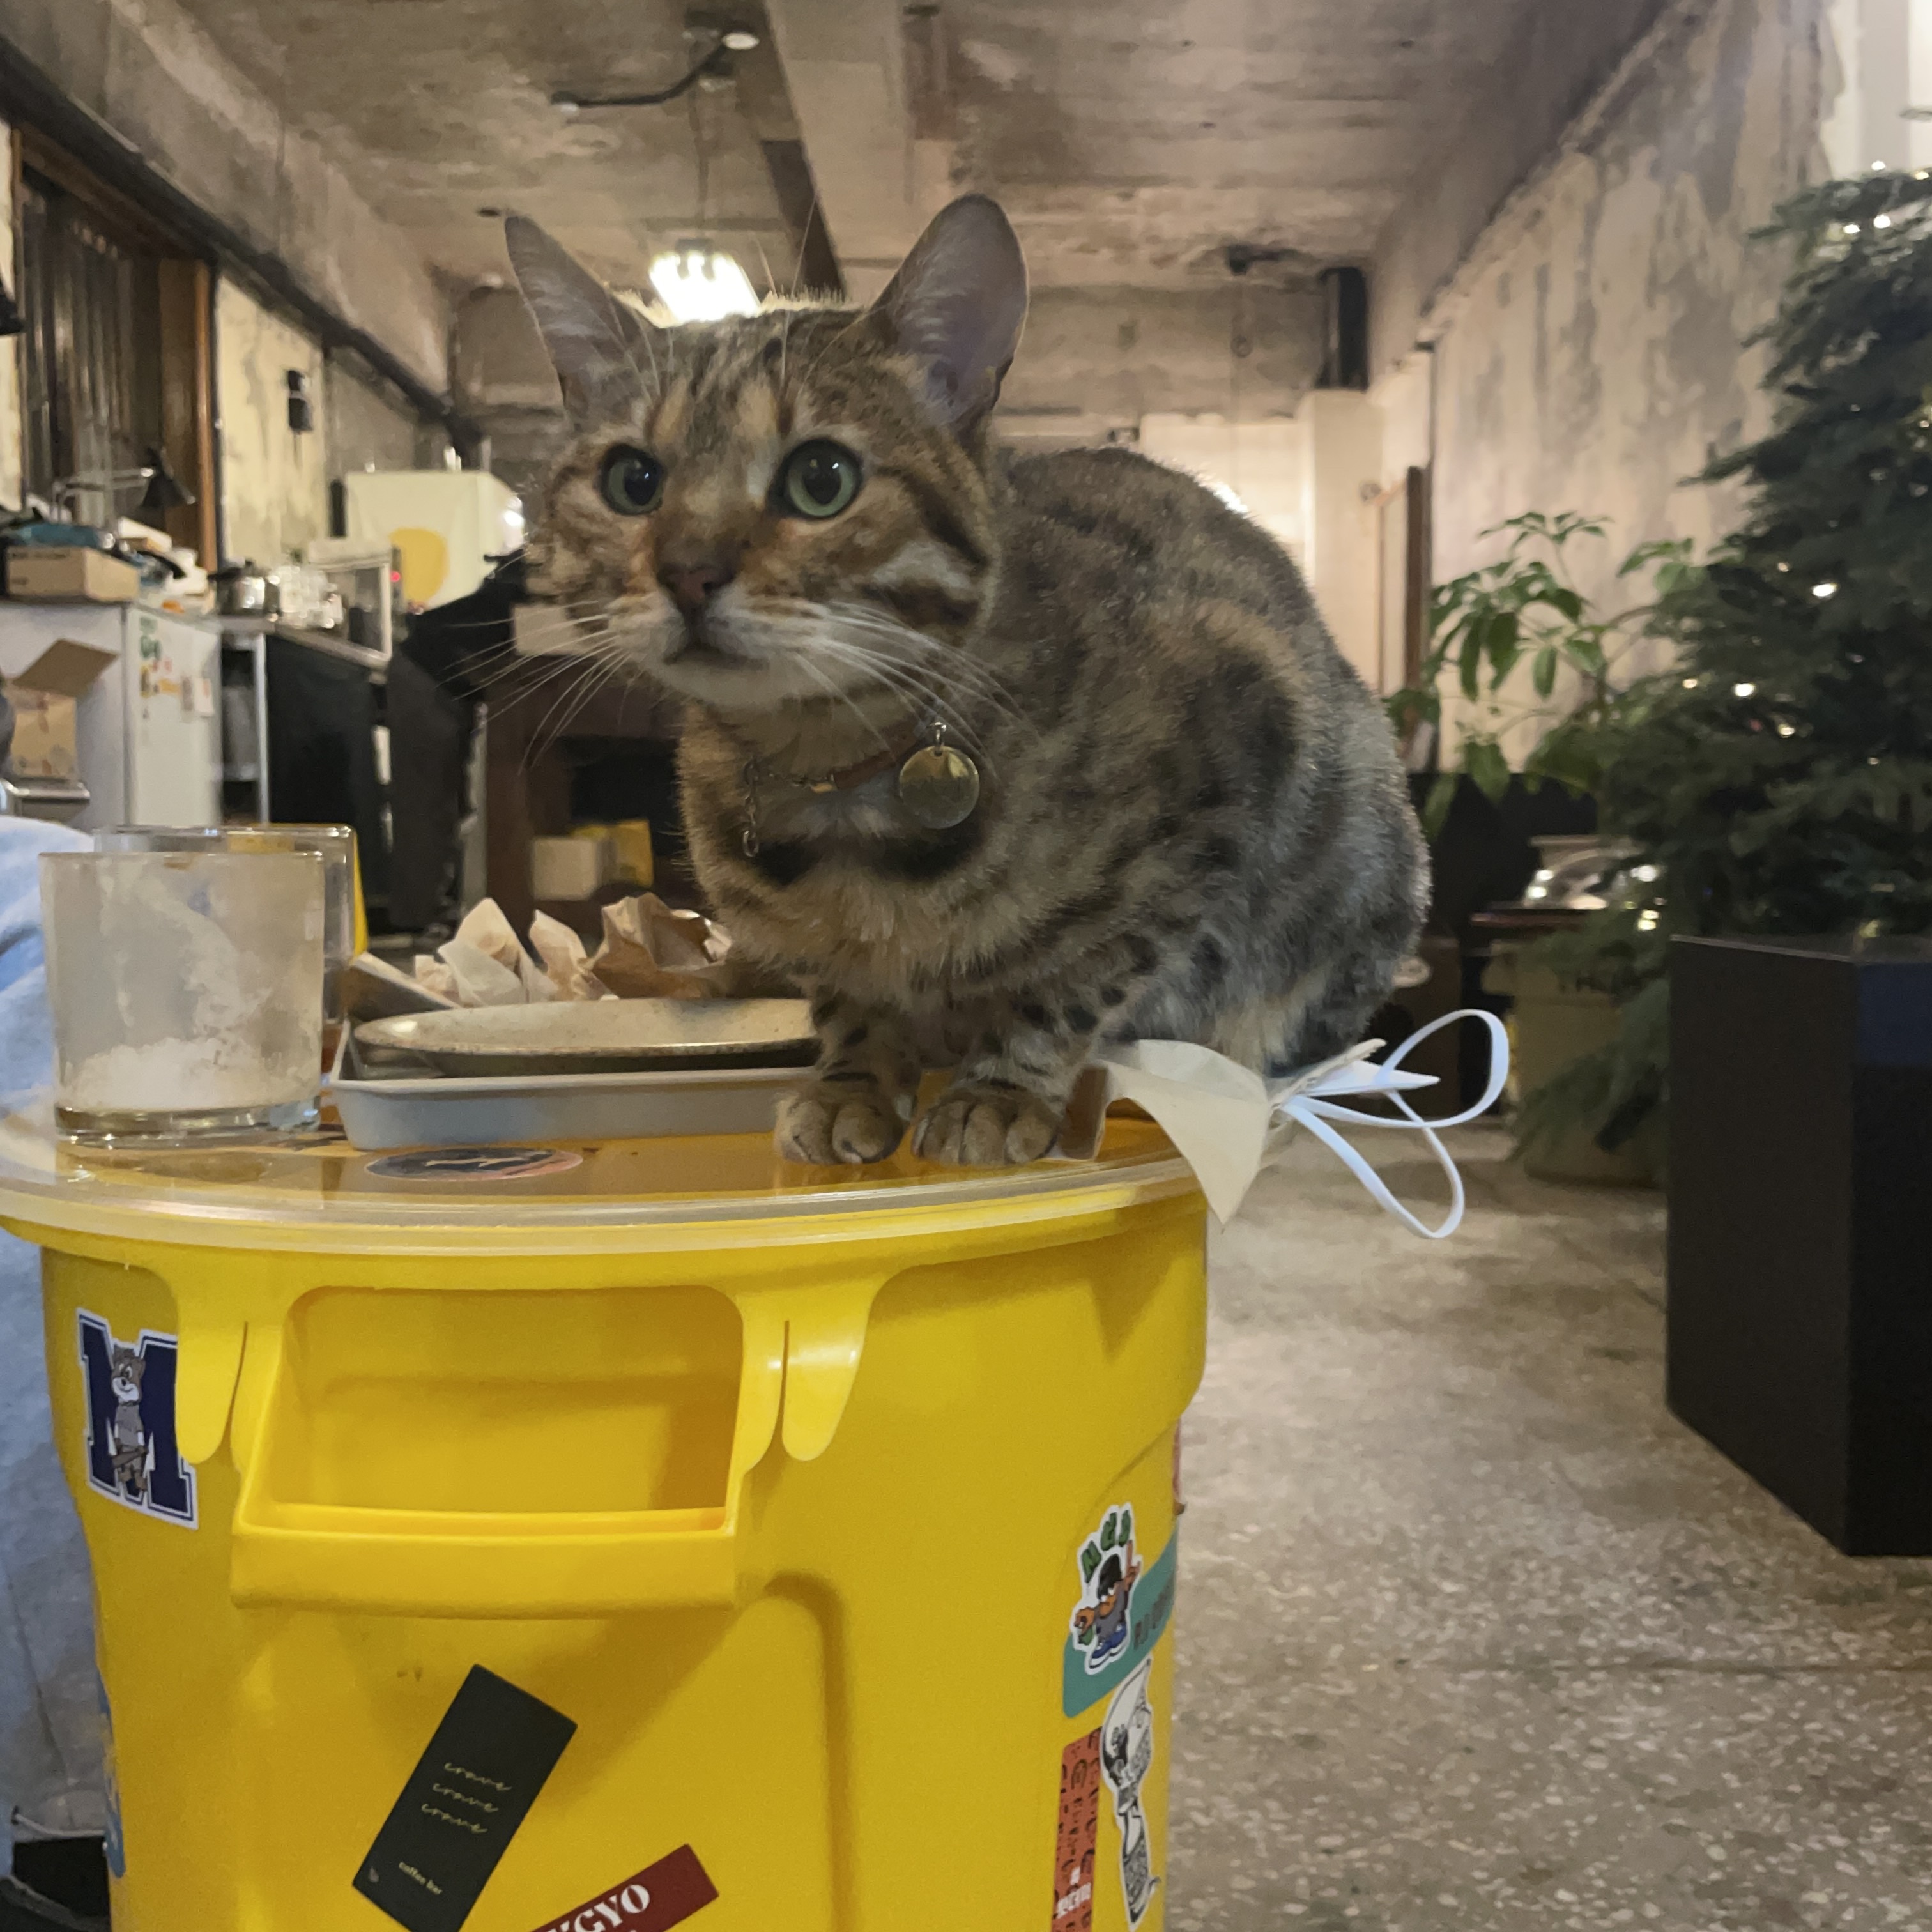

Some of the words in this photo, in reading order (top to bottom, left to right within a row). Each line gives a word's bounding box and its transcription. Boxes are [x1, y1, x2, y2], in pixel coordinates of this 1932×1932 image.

[398, 1862, 426, 1885] coffee
[426, 1879, 443, 1895] bar
[546, 1884, 650, 1932] GYO
